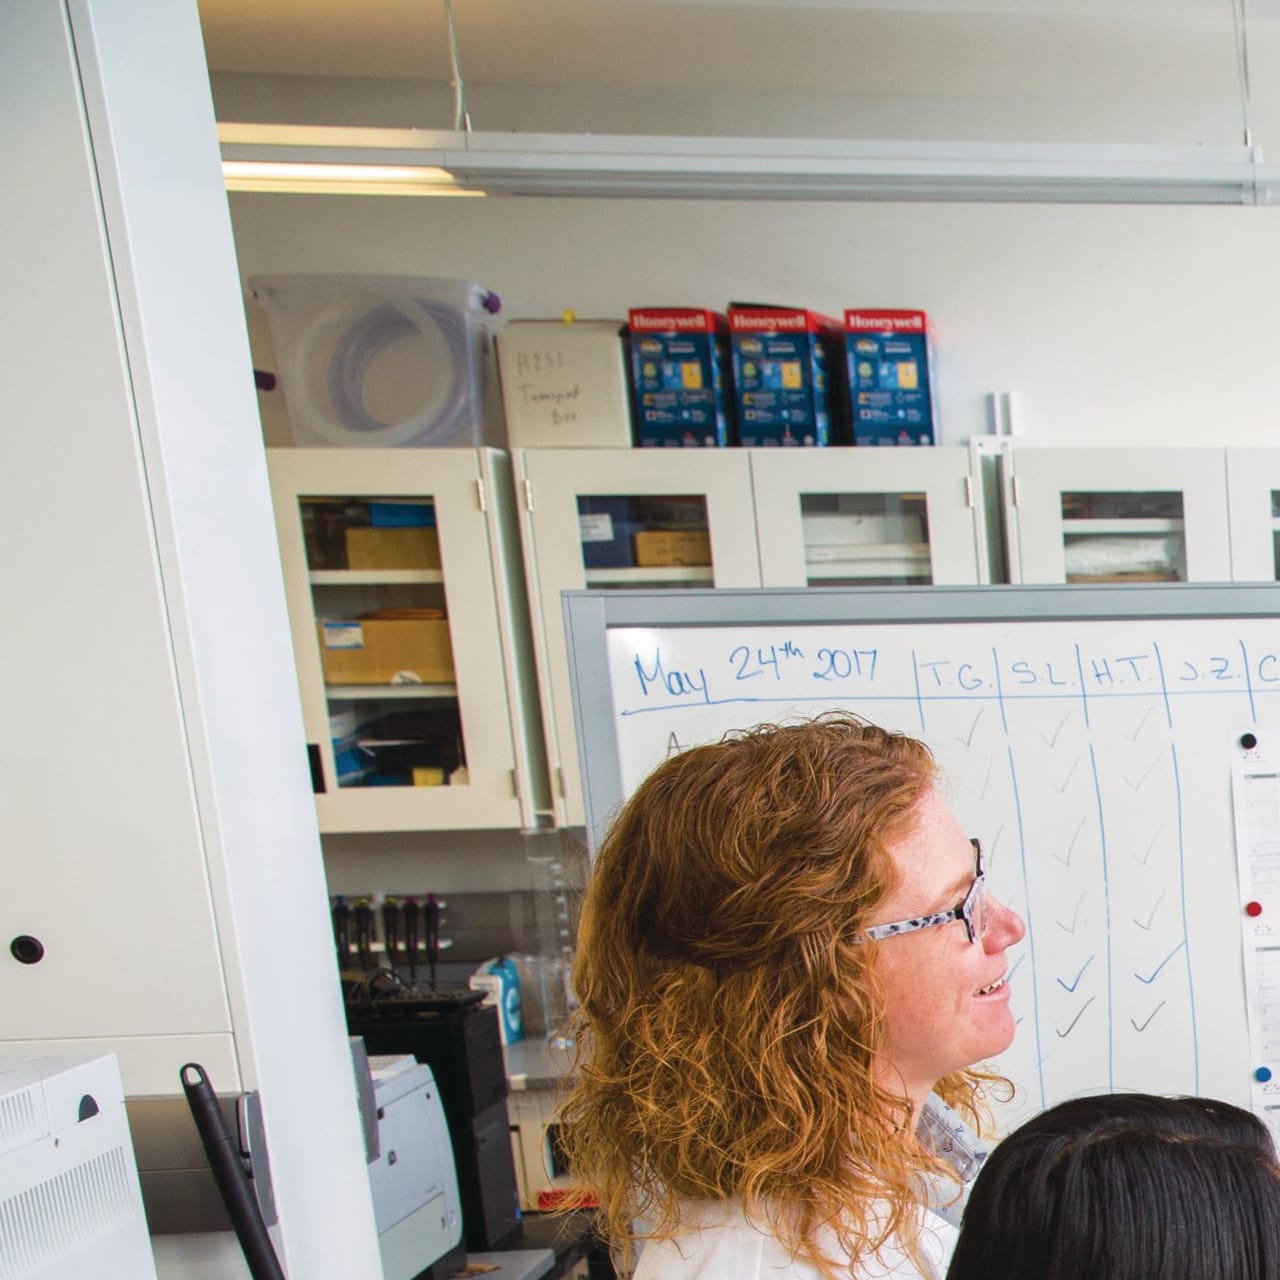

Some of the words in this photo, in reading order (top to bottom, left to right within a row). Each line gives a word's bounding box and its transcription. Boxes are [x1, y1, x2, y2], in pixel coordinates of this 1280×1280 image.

[633, 315, 706, 333] Honeywell
[733, 314, 806, 333] Honeywell
[849, 315, 923, 332] Honeywell
[633, 648, 712, 703] May
[730, 640, 805, 681] 24th
[813, 648, 878, 682] 2017
[920, 661, 993, 690] T.G.
